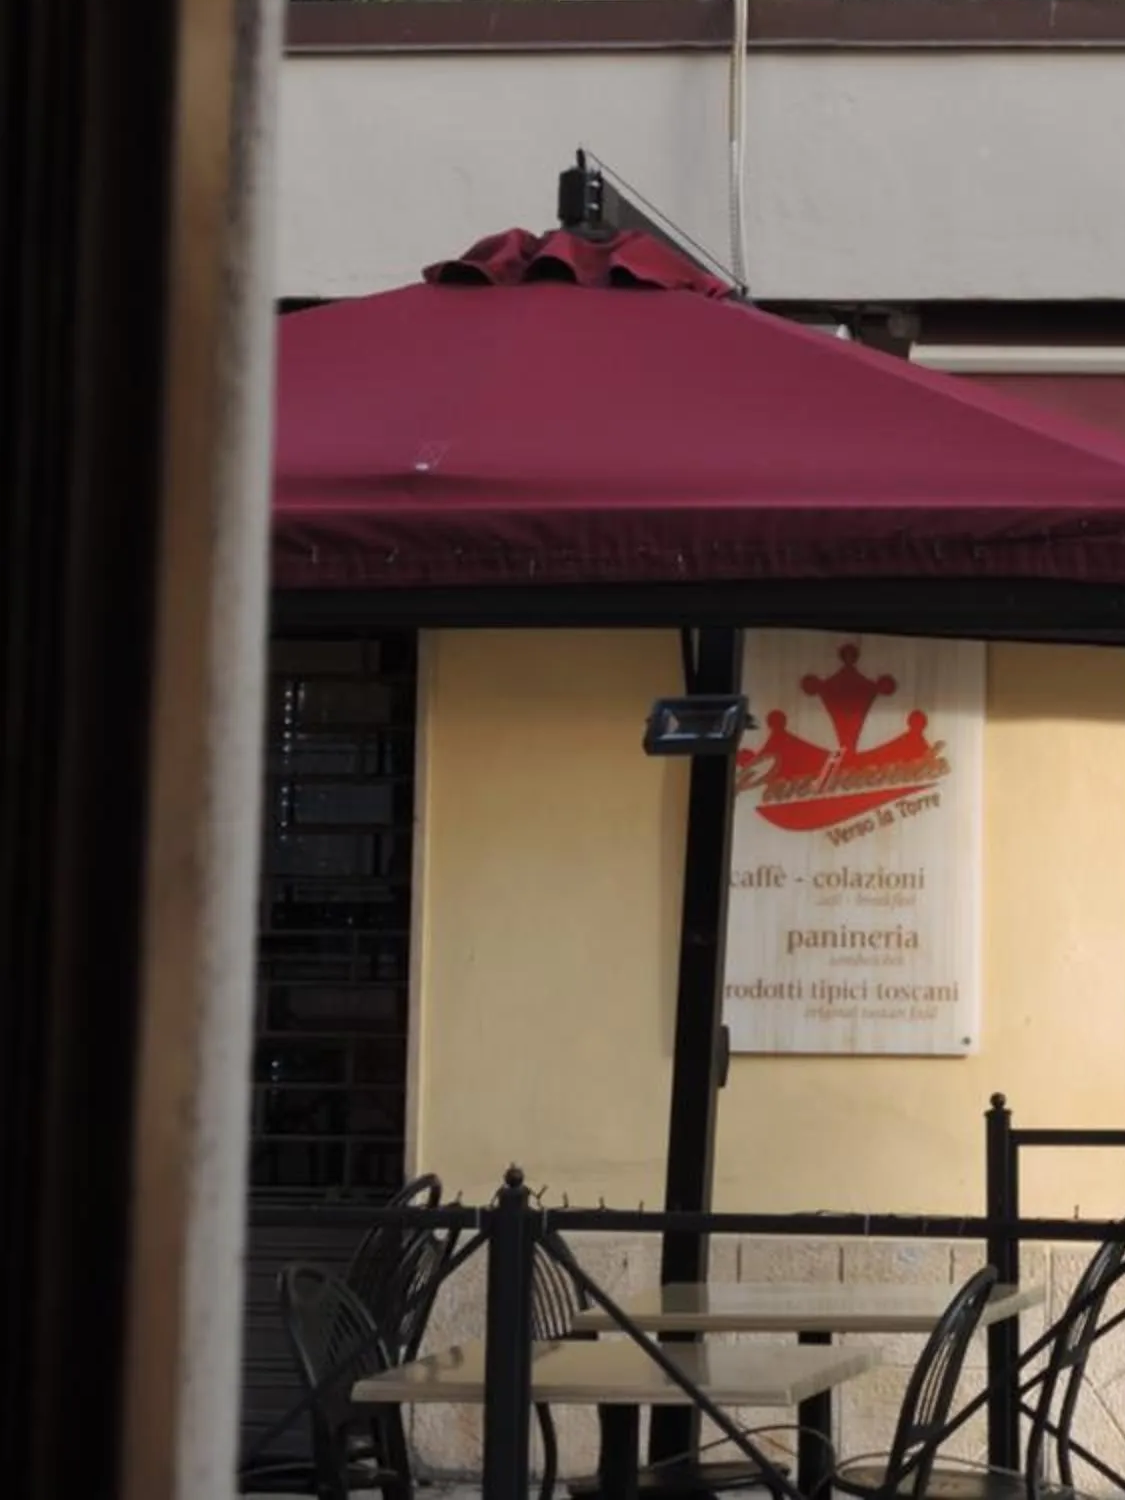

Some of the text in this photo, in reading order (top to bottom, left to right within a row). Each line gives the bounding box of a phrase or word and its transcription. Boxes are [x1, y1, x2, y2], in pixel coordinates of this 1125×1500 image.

[729, 865, 787, 889] caffè
[812, 866, 925, 889] colazioni
[786, 925, 919, 954] panineria
[725, 978, 959, 1004] rodotti tipici toscani
